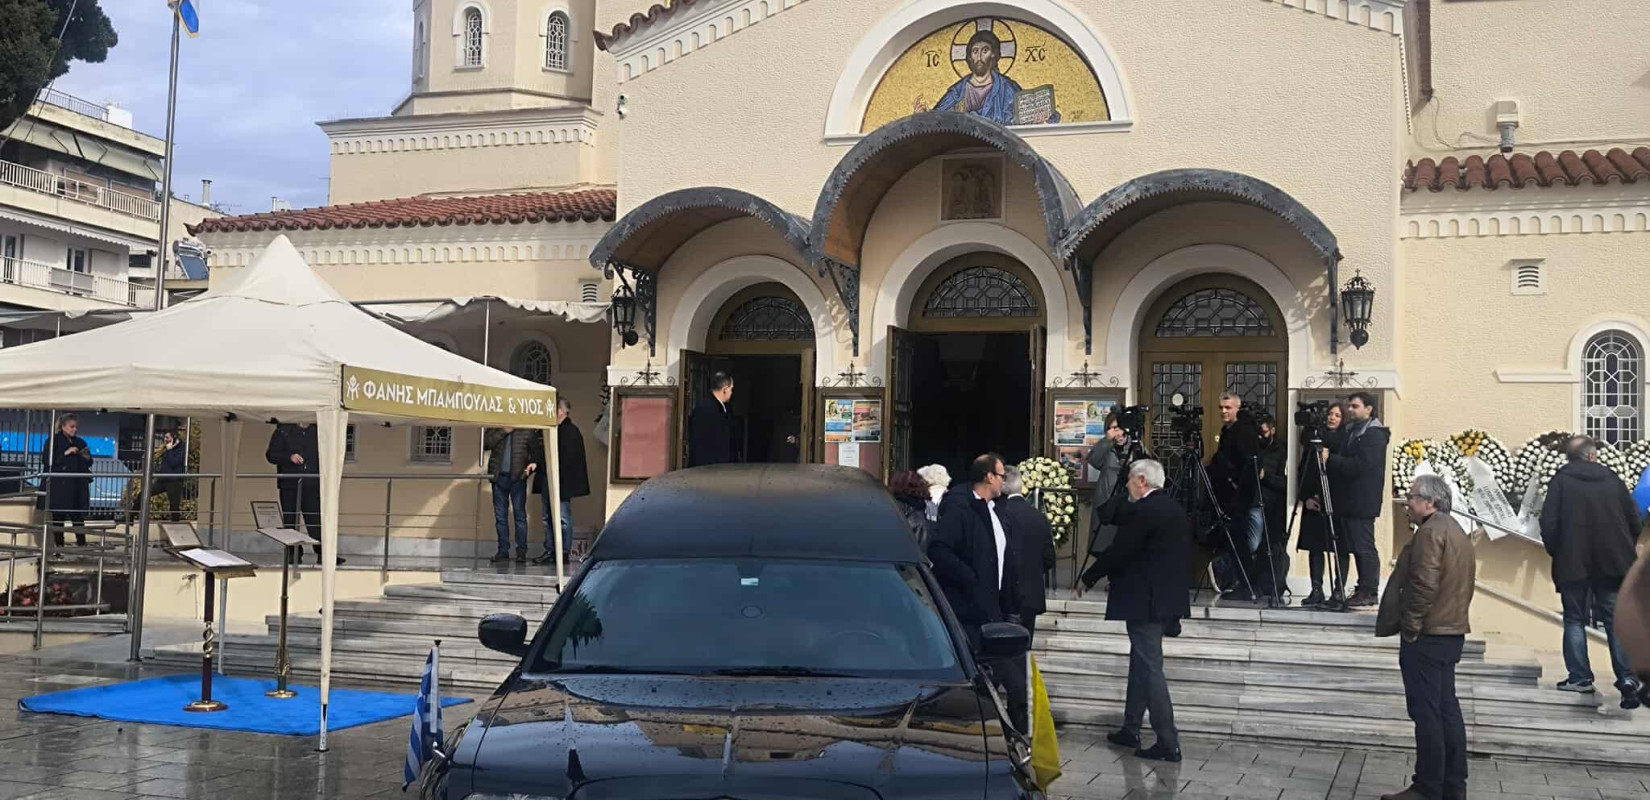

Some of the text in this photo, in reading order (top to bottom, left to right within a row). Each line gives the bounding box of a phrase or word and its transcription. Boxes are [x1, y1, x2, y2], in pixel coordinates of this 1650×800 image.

[363, 380, 544, 415] ΦΑΝΗΣ ΜΠΑΜΠΟΥΛΑΣ & ΥΙΟΣ
